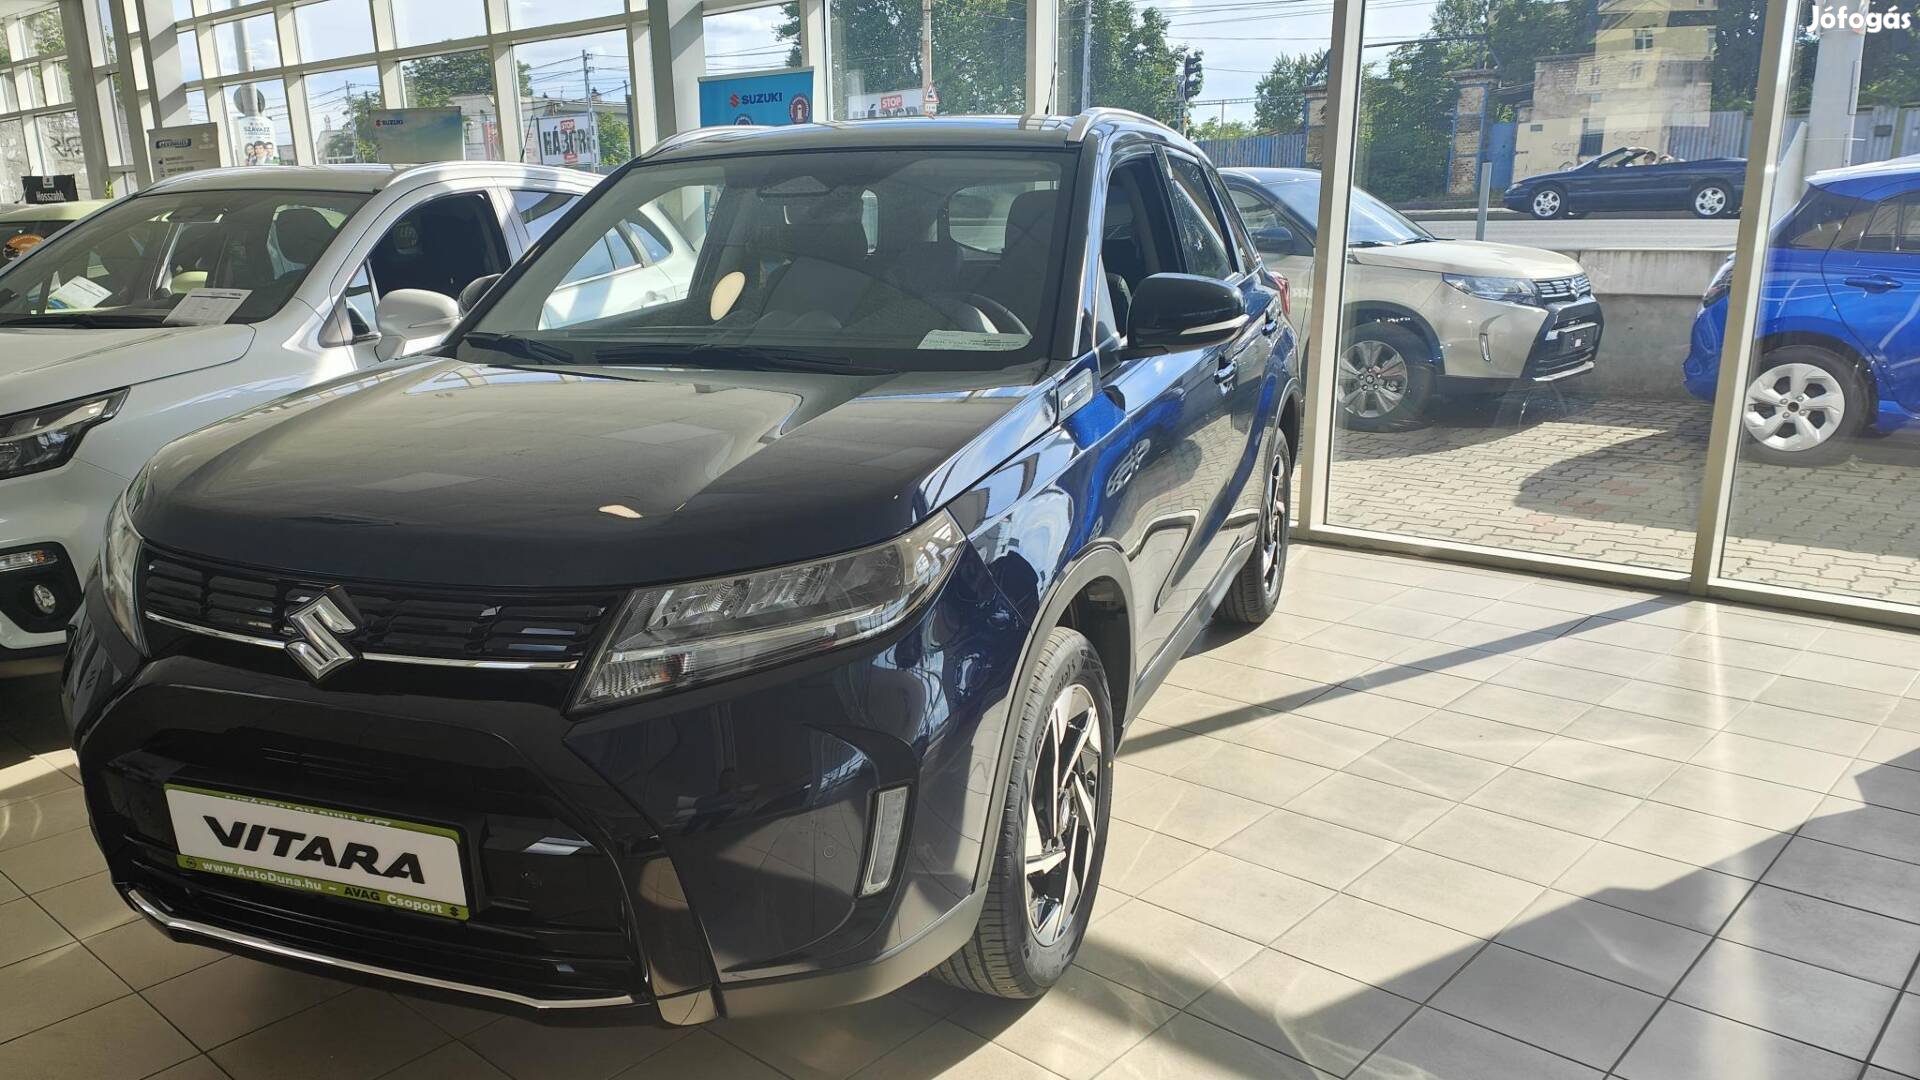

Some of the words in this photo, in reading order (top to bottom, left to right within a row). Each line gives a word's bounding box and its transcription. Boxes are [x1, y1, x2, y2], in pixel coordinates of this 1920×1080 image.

[742, 93, 783, 105] SUZUKI
[881, 97, 902, 109] STOP
[203, 815, 425, 884] VITARA
[202, 861, 322, 891] www.AutoDuna.hu
[344, 887, 380, 901] AVAG
[387, 894, 443, 914] Csoport
